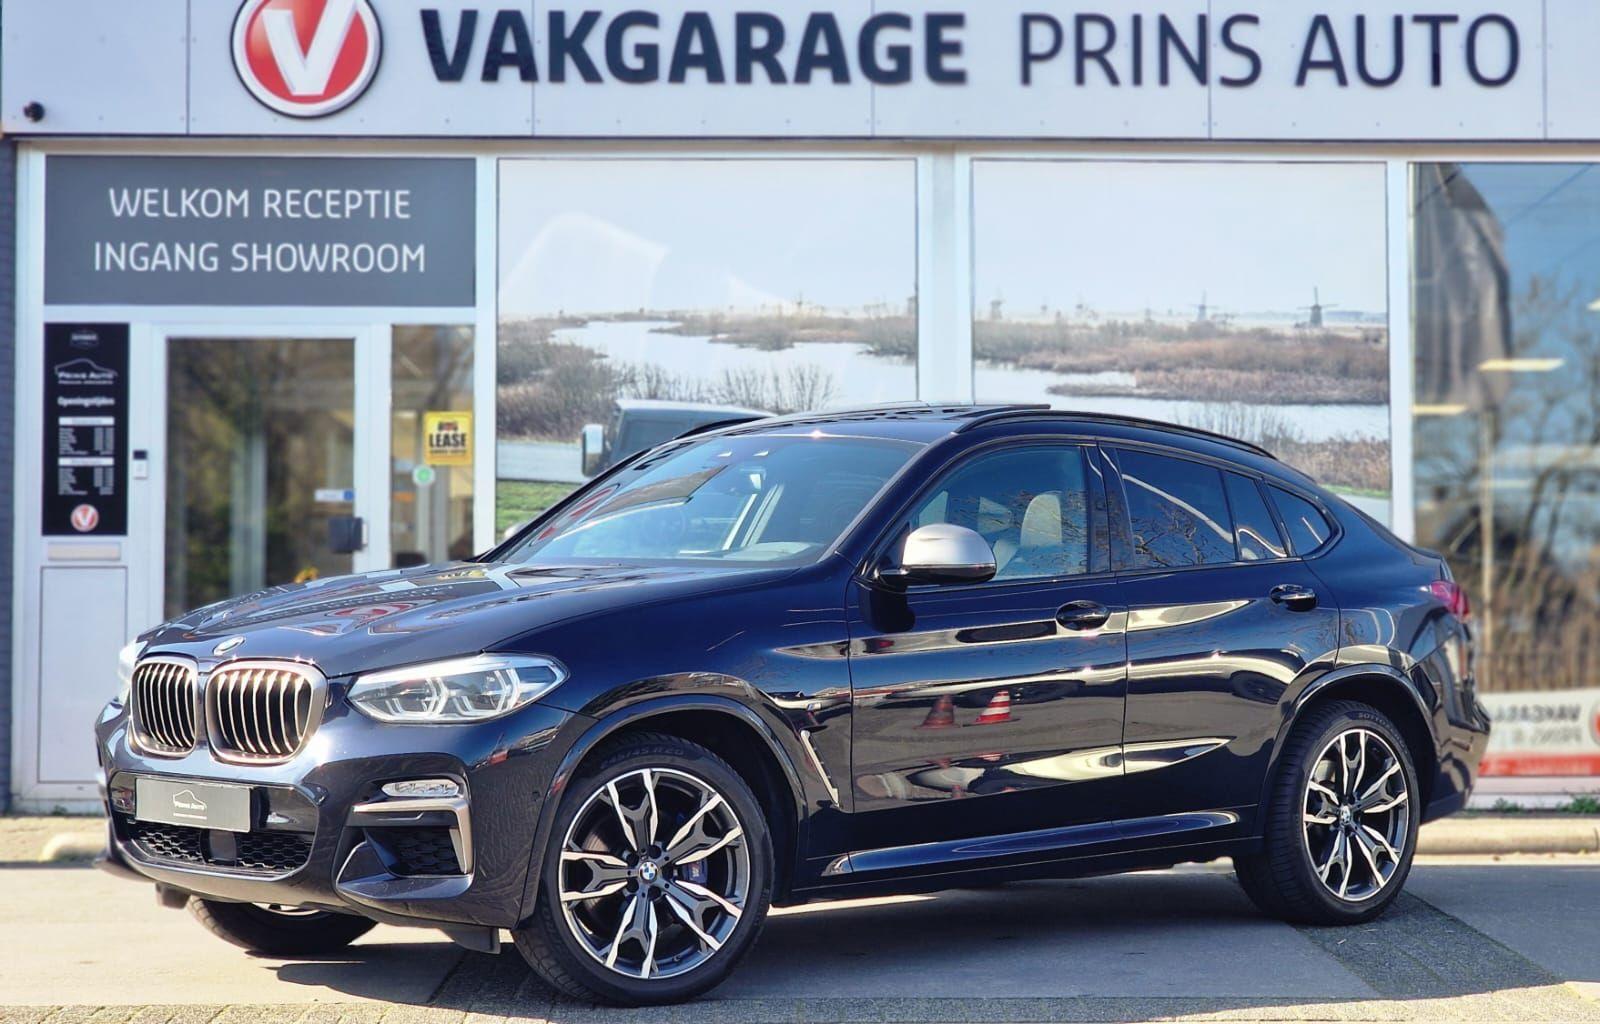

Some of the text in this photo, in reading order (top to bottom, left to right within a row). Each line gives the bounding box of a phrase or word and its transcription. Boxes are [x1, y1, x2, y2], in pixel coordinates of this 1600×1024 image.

[420, 10, 1520, 88] VAKGARAGE PRINS AUTO
[108, 187, 411, 220] WELKOM RECEPTIE
[94, 241, 425, 274] INGANG SHOWROOM
[429, 434, 467, 447] LEASE
